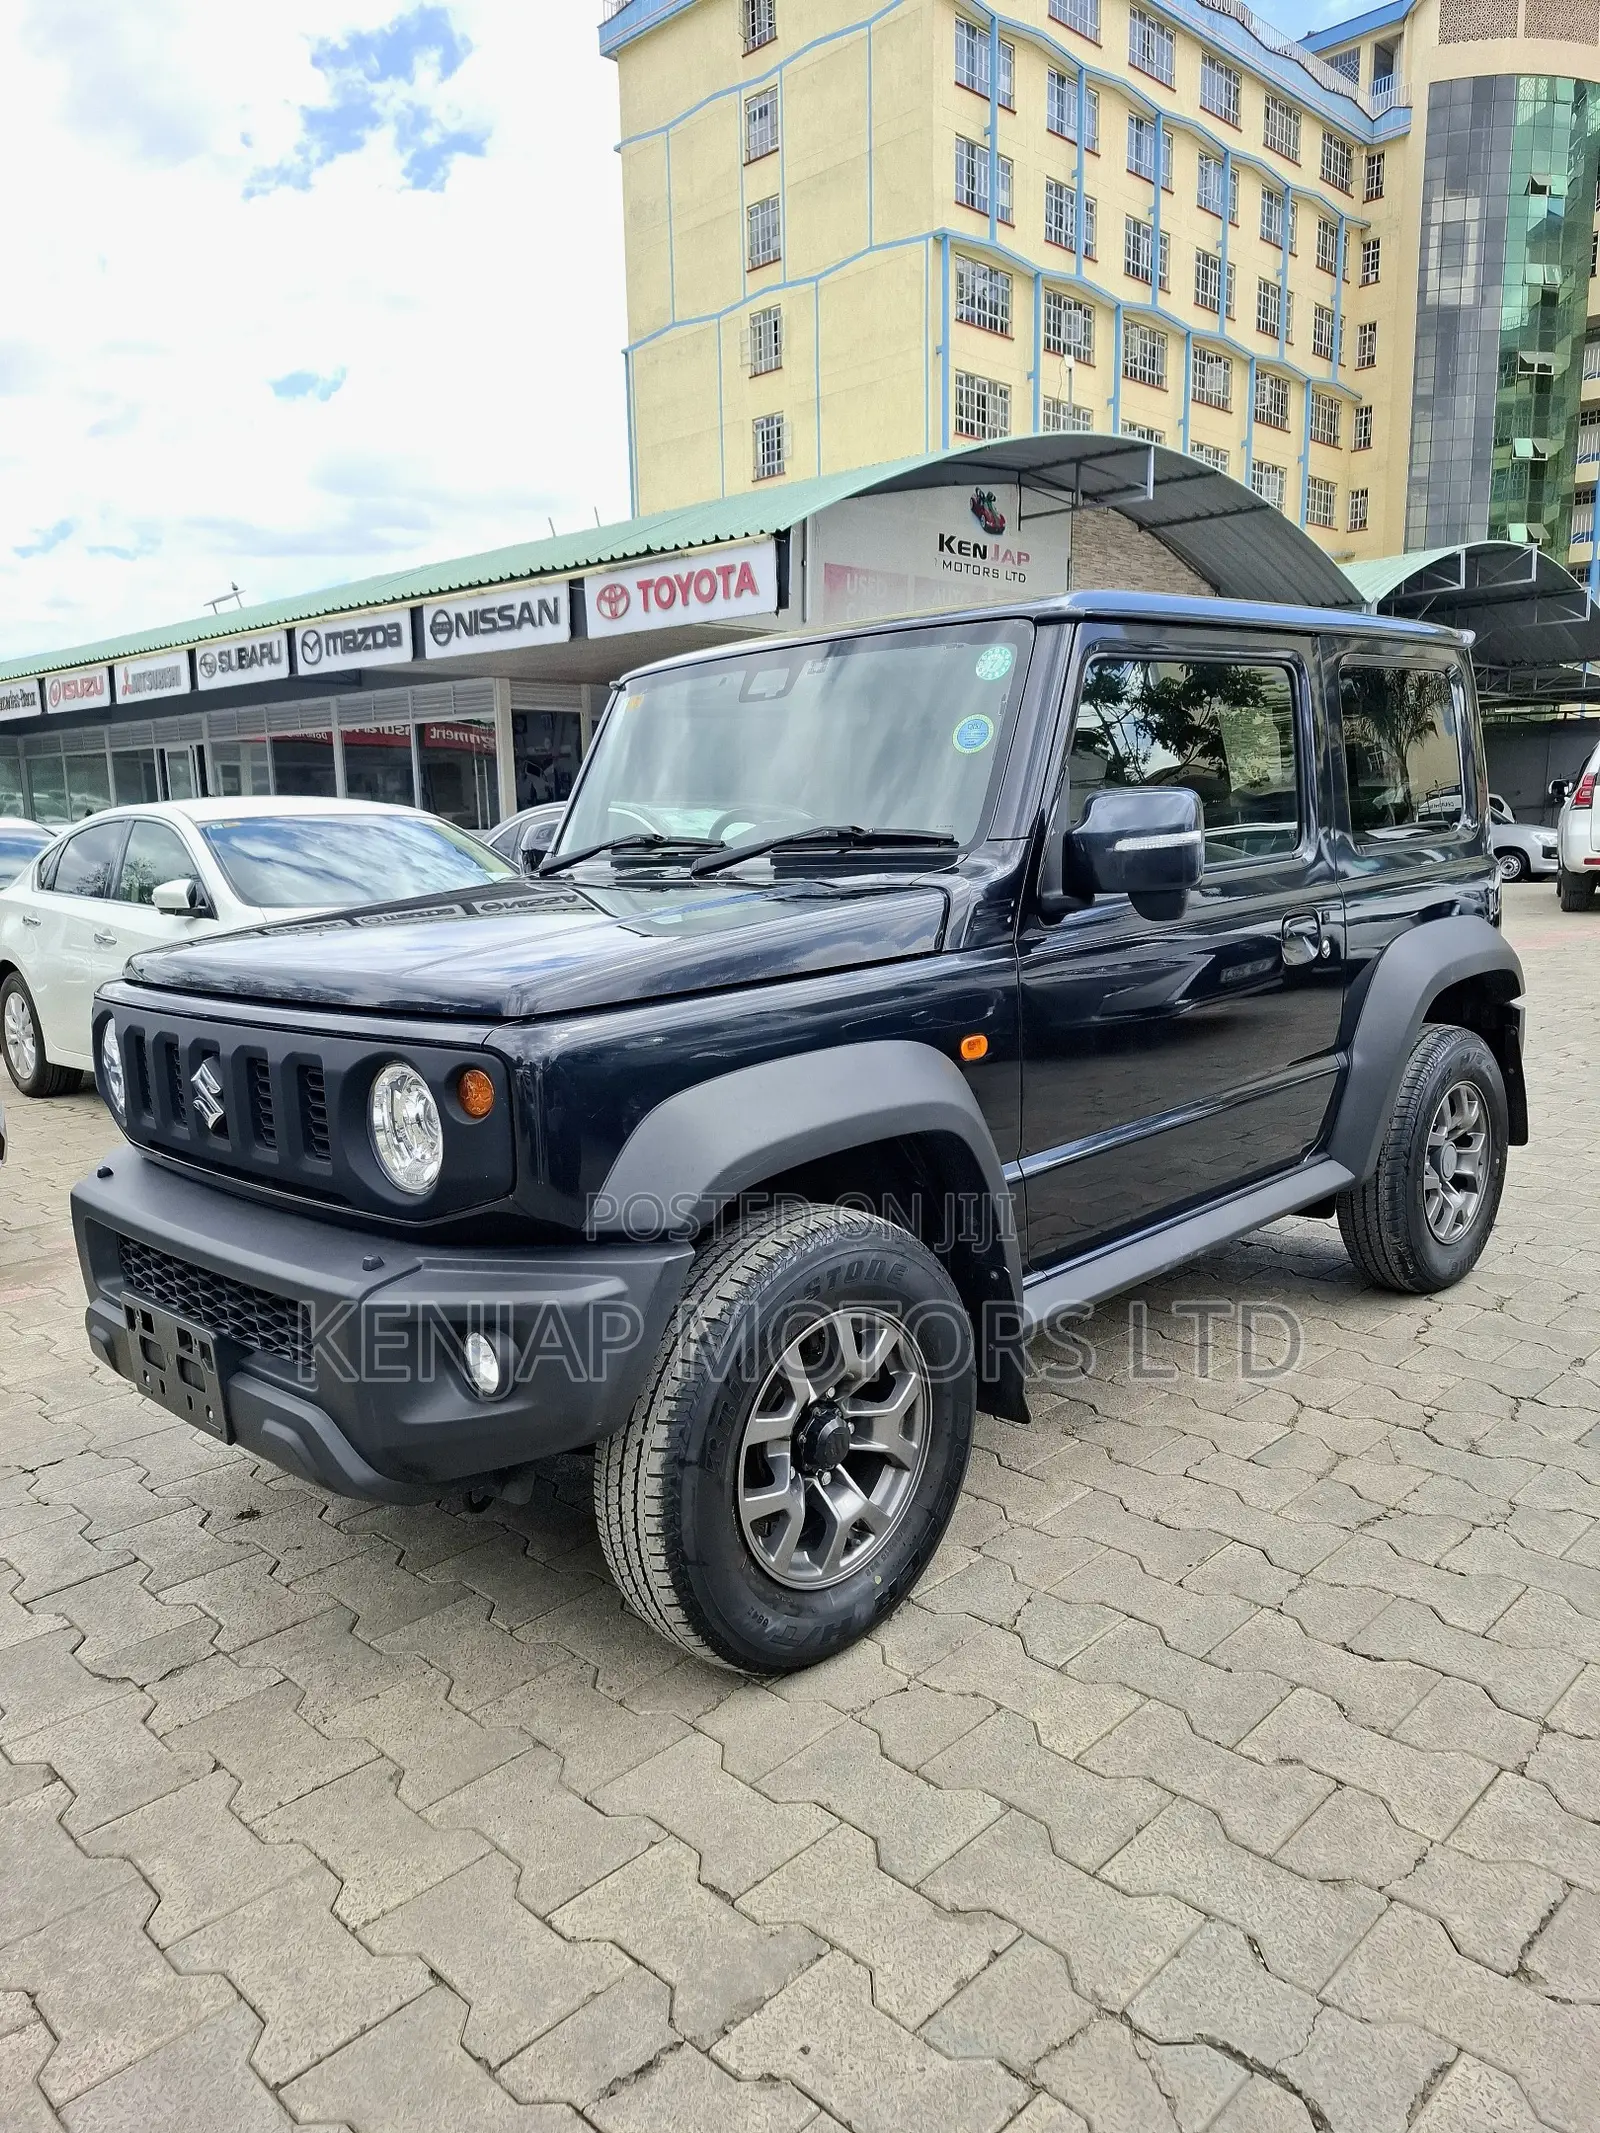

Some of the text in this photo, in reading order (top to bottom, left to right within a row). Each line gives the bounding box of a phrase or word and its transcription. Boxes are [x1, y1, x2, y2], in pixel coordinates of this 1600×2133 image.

[938, 533, 1031, 567] KENJAP
[637, 561, 759, 613] TOYOTA
[942, 559, 1027, 584] MOTORS LTD
[455, 597, 561, 638] NISSAN
[217, 639, 282, 673] SUBARU
[62, 675, 105, 701] ISUZU
